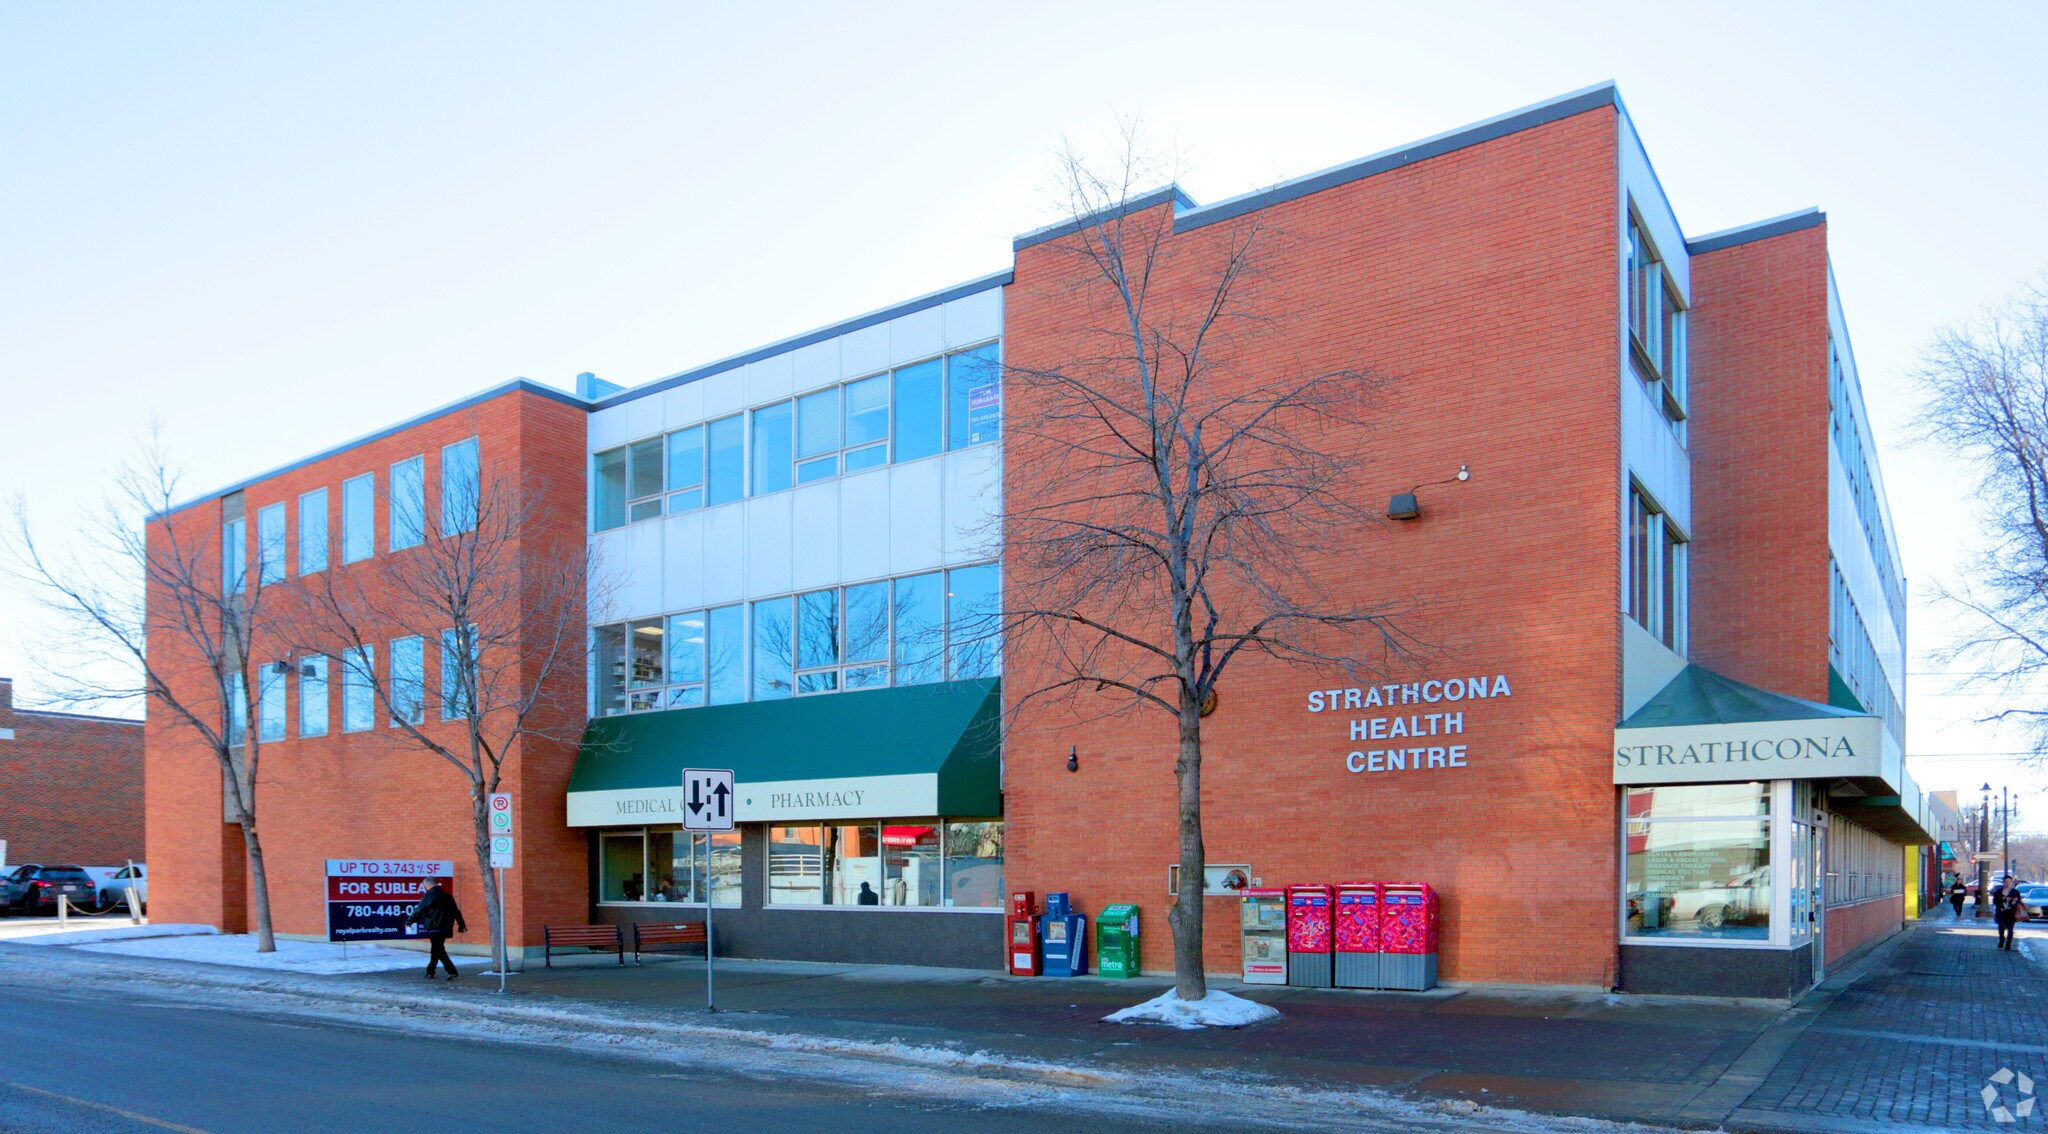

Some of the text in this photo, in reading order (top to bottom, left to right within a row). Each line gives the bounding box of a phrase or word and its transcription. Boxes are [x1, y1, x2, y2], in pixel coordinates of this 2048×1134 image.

[1307, 675, 1512, 712] STRATHCONA
[1350, 712, 1463, 741] HEALTH
[1346, 745, 1468, 773] CENTRE
[1616, 735, 1857, 768] STRATHCONA
[616, 798, 676, 814] MEDICAL
[771, 790, 865, 809] PHARMACY
[339, 862, 357, 874] UP
[360, 862, 379, 874] TO
[383, 863, 415, 875] 3,743
[426, 863, 440, 874] SF
[339, 882, 442, 895] FOR SUBLEA
[346, 905, 419, 917] 780-448-0
[335, 927, 398, 935] royalparkrealty.com
